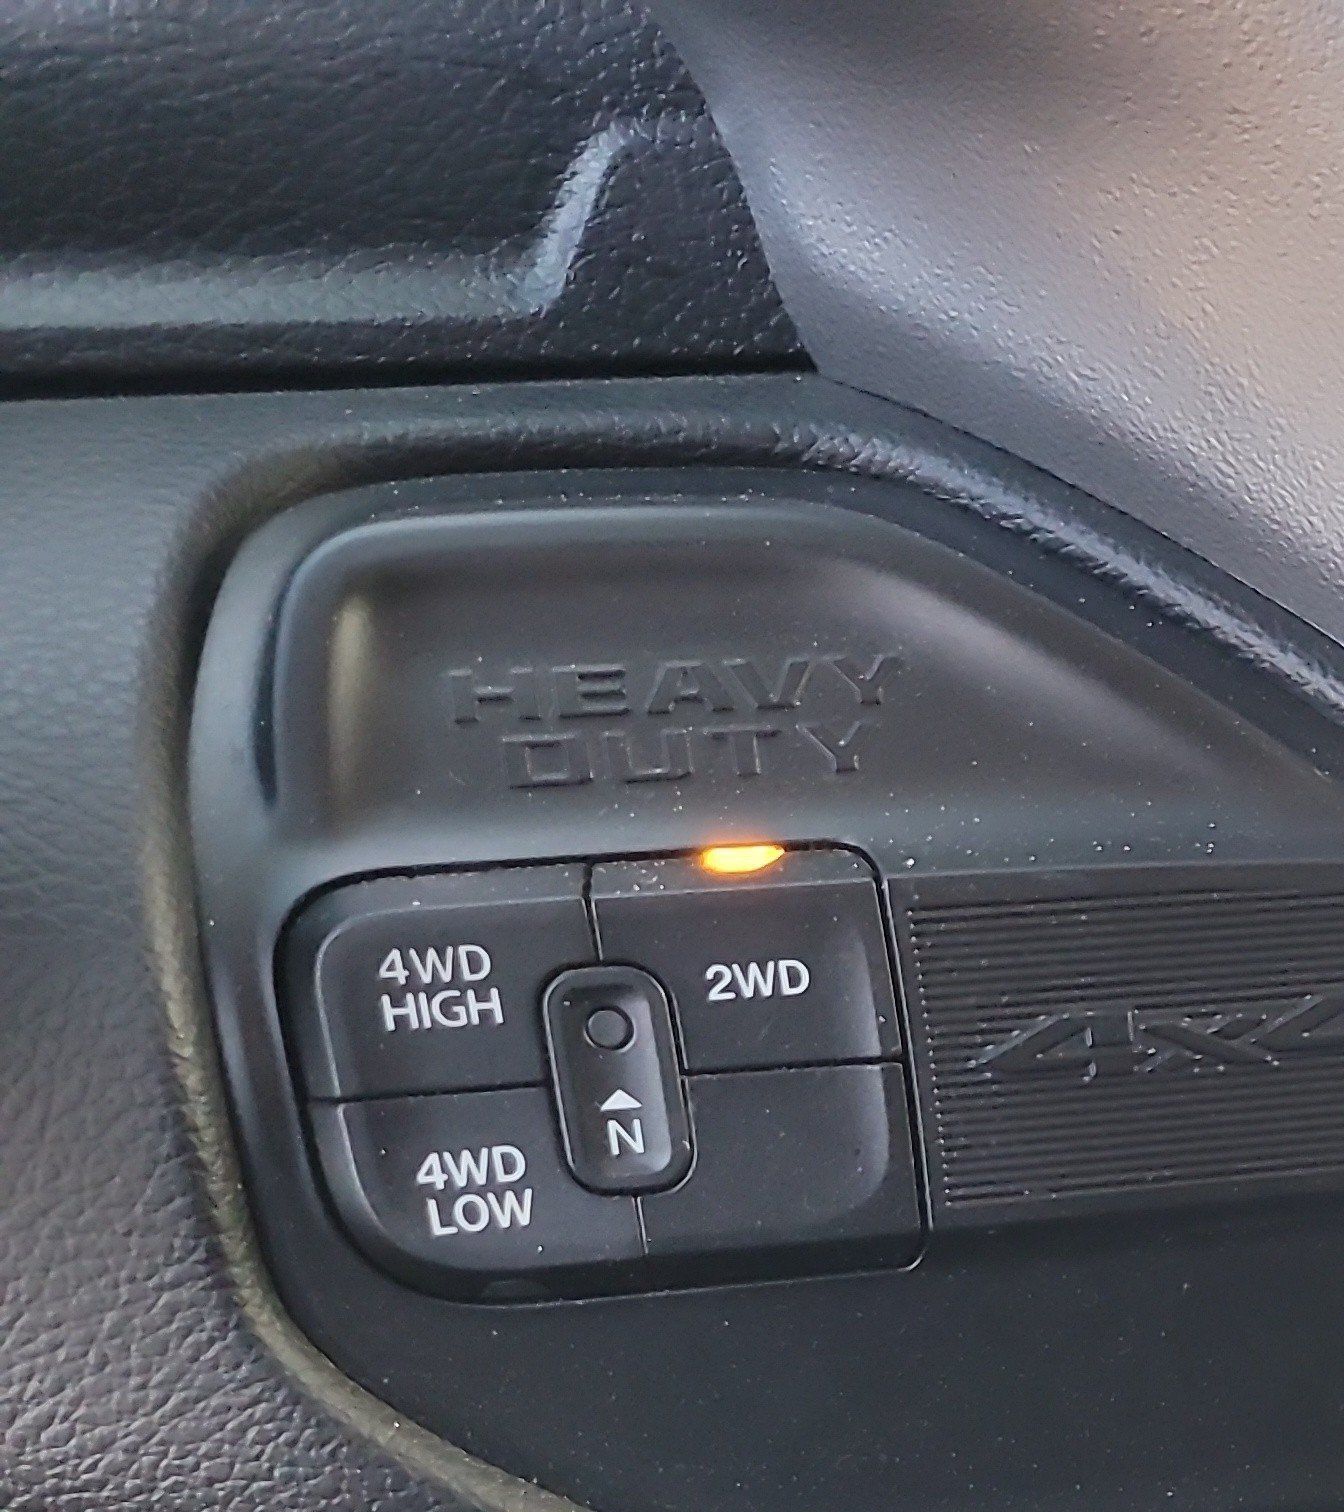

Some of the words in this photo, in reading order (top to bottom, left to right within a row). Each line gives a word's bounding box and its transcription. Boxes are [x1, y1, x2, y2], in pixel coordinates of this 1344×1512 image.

[447, 654, 900, 724] HEAVY
[502, 718, 870, 790] DUTY
[378, 944, 492, 985] 4WD
[704, 959, 810, 1002] 2WD
[380, 988, 505, 1032] HIGH
[606, 1118, 646, 1156] N
[416, 1145, 527, 1190] 4WD
[426, 1188, 533, 1237] LOW
